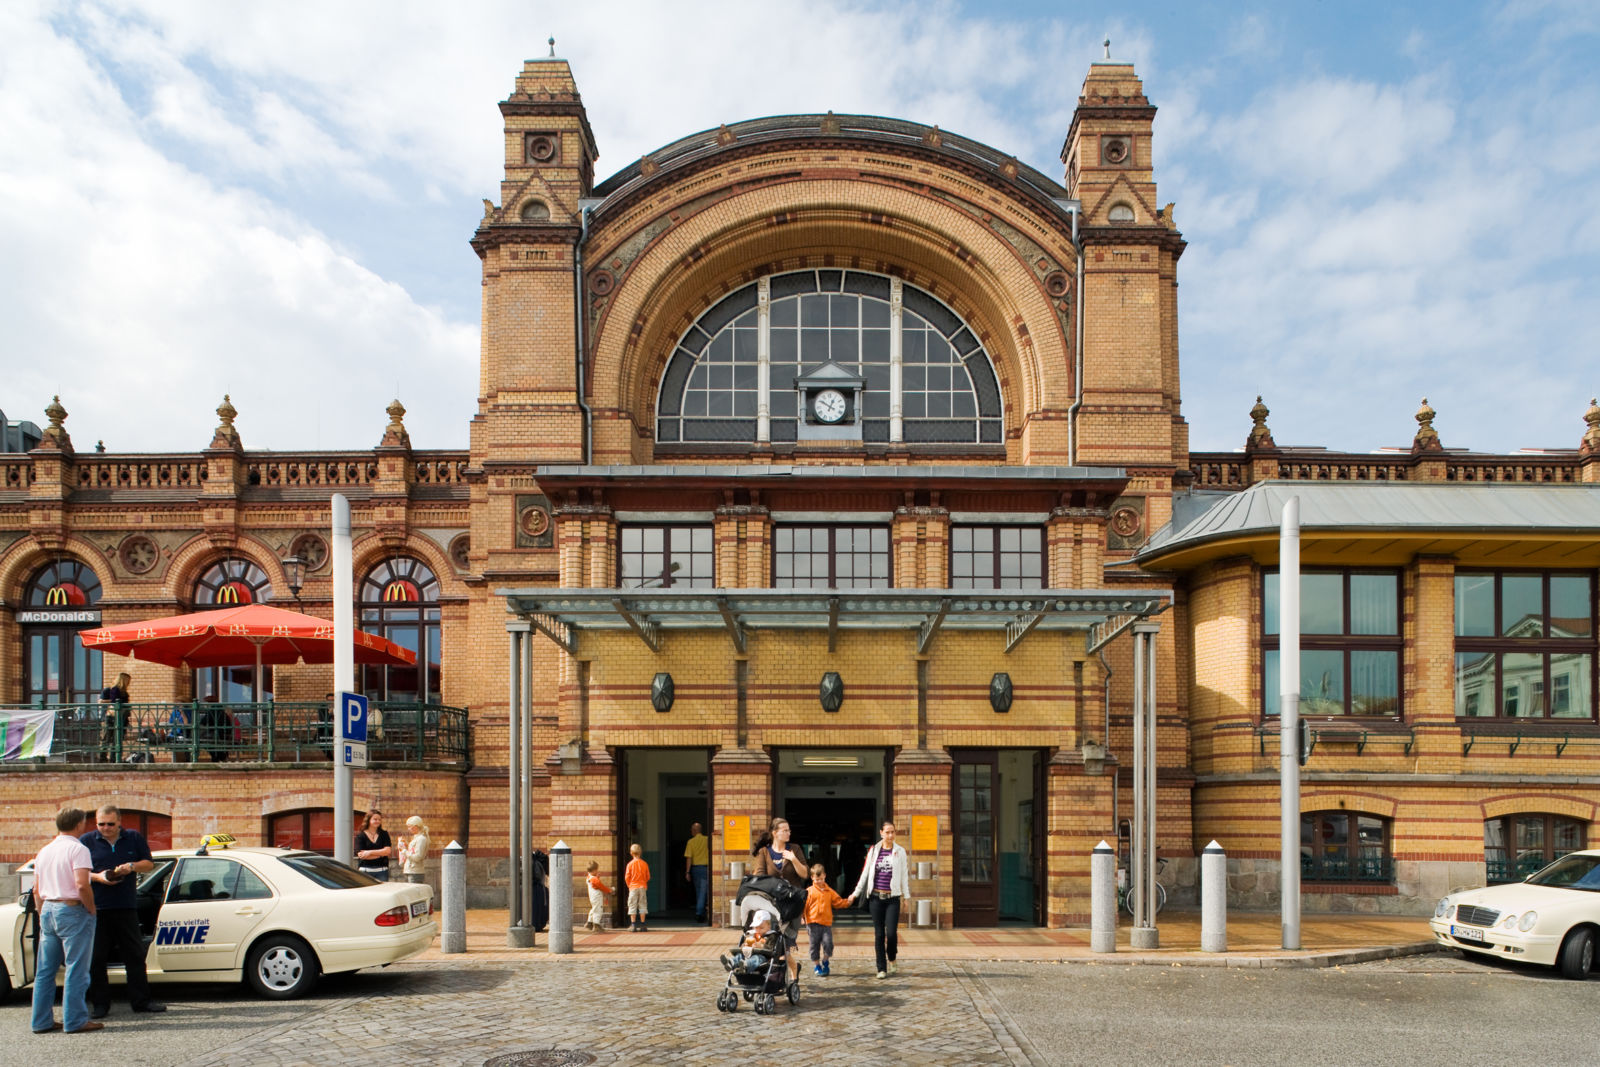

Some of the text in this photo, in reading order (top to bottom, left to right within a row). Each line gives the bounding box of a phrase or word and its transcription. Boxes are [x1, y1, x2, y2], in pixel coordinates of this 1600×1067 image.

[21, 611, 95, 622] McDonald's
[348, 699, 361, 733] P
[159, 918, 210, 927] beste vielfalt
[156, 925, 210, 945] NNE
